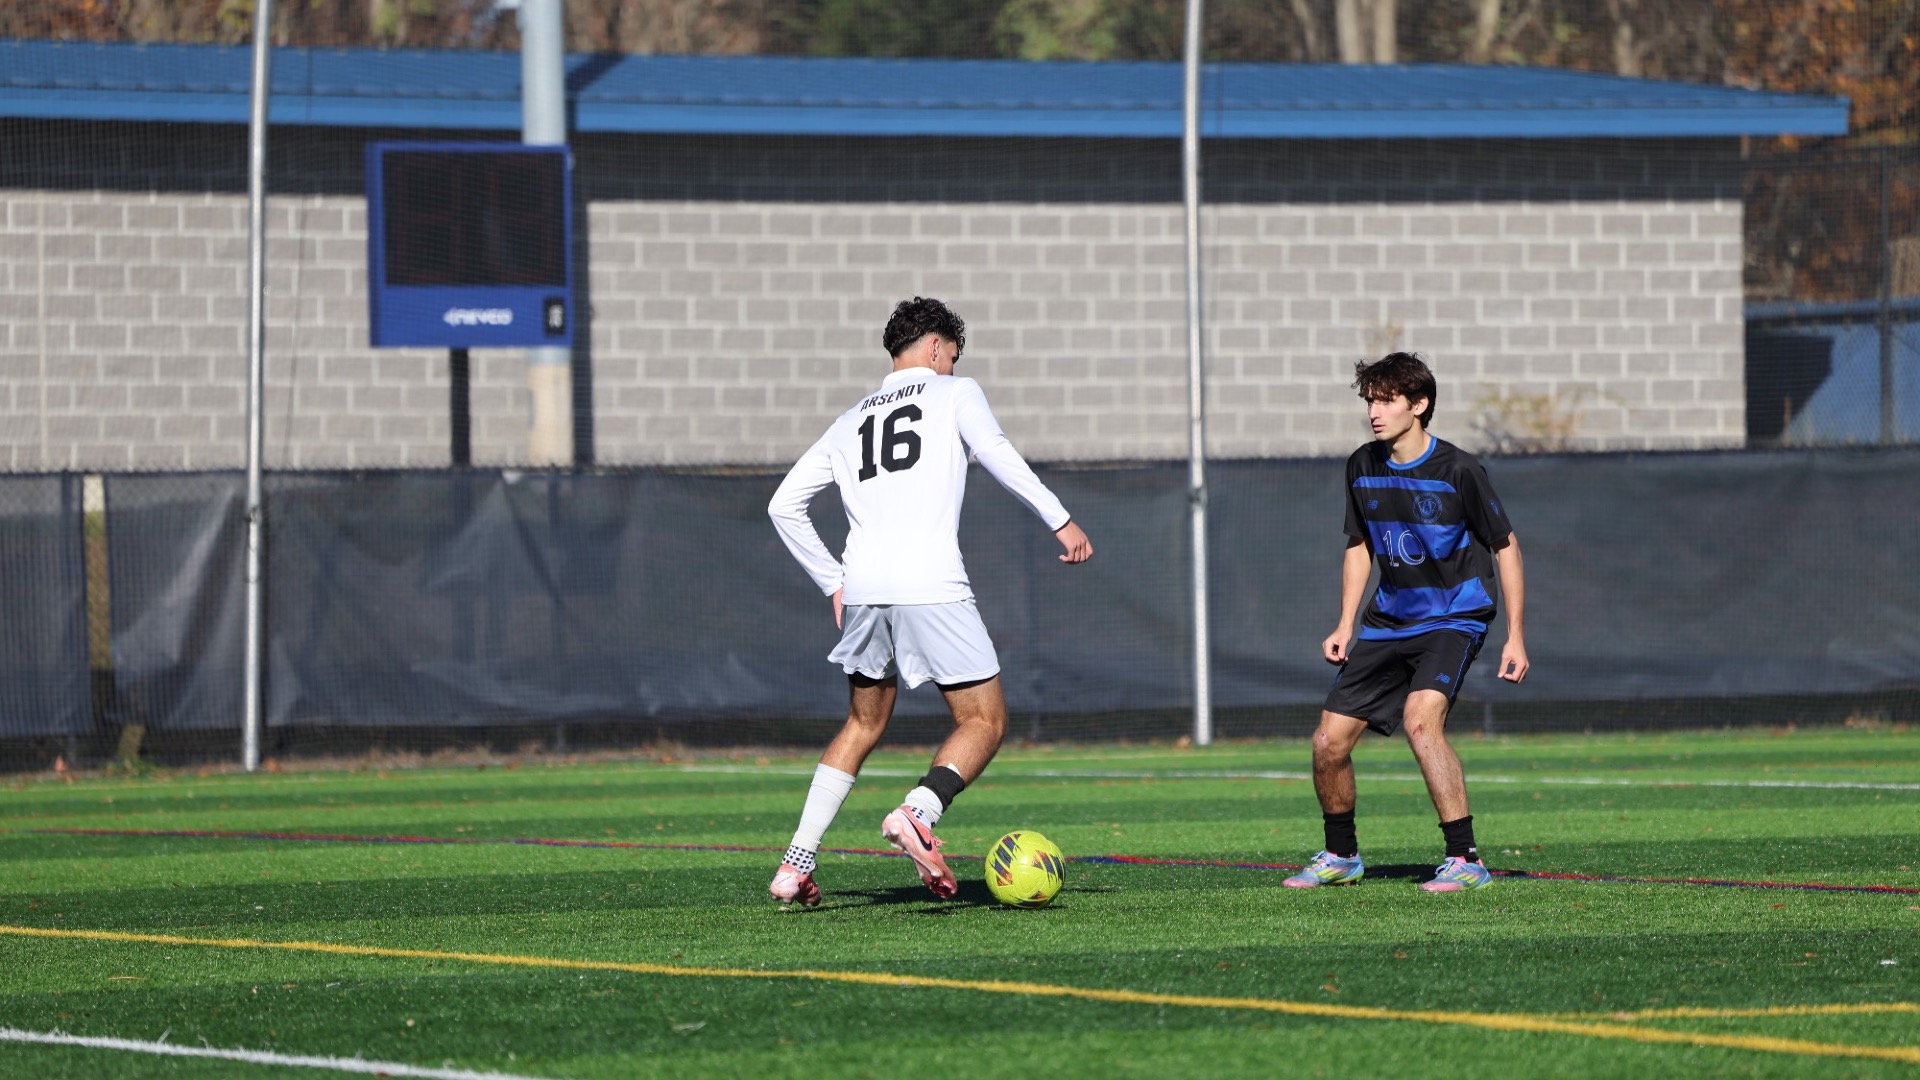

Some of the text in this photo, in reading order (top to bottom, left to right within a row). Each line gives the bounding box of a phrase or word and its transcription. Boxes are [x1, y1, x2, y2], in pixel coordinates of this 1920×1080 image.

[860, 383, 926, 412] ARSENOV
[858, 403, 922, 482] 16
[1382, 530, 1426, 567] 10
